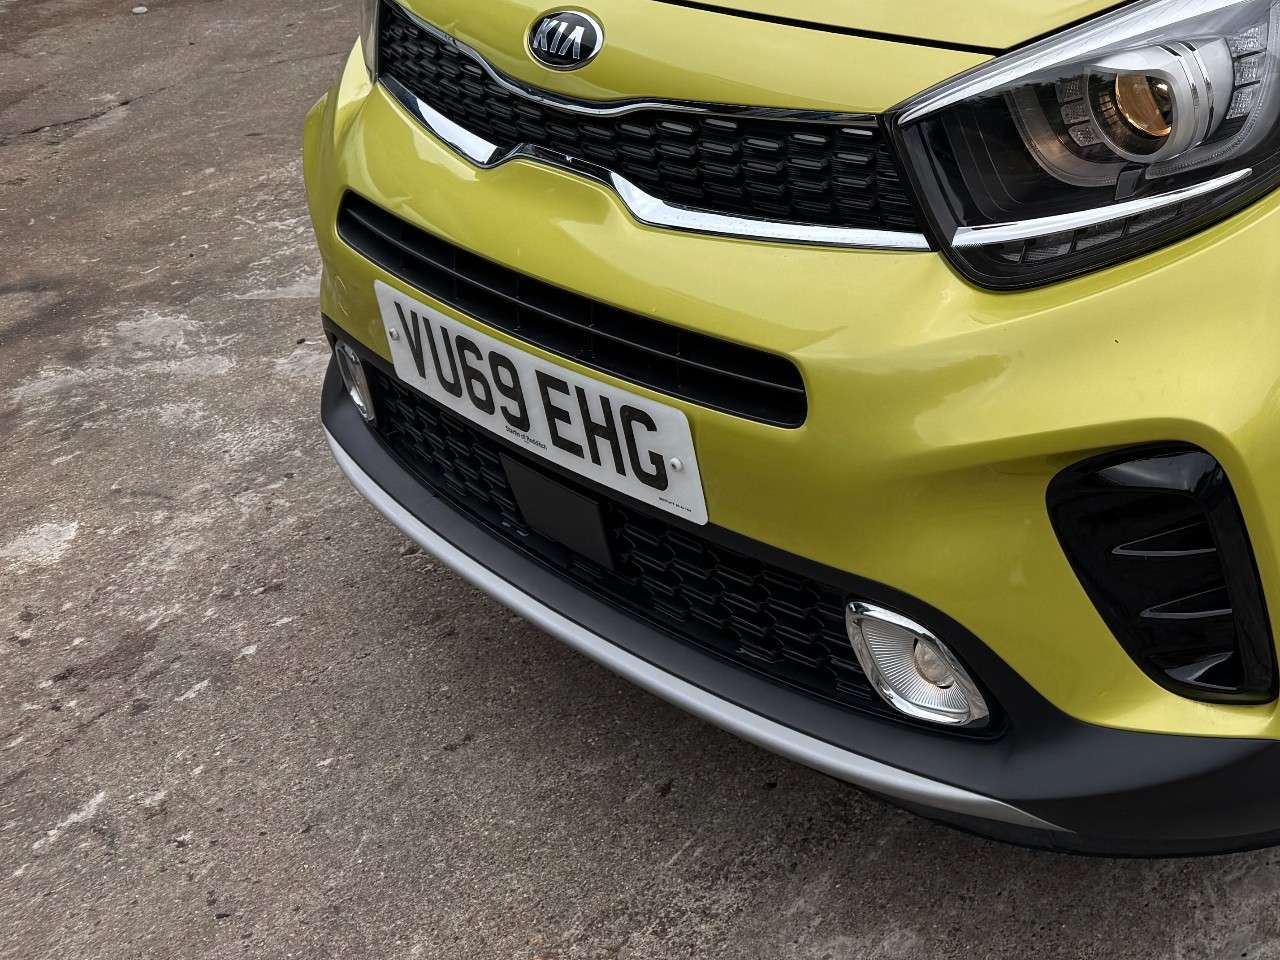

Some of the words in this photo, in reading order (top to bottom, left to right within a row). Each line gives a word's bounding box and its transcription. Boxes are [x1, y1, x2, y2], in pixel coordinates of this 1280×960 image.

[532, 18, 585, 60] KIA
[394, 300, 531, 433] VU69
[535, 369, 669, 491] EHG
